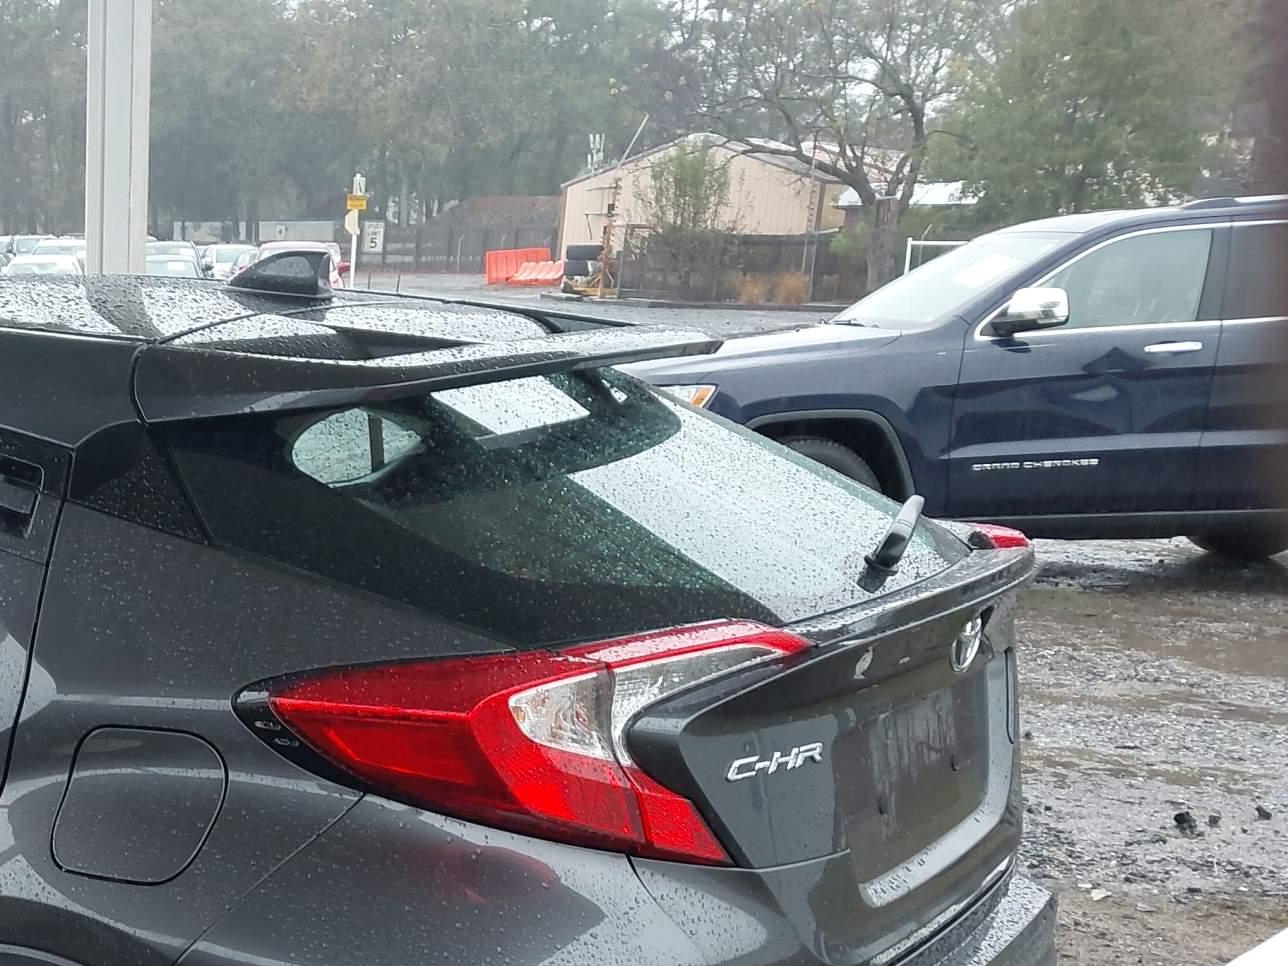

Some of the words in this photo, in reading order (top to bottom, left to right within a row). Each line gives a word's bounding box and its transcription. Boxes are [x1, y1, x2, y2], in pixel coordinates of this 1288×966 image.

[369, 237, 378, 249] 5
[972, 462, 1020, 471] GRAND
[1023, 458, 1099, 468] CHEROKEE
[727, 742, 823, 781] C-HR
